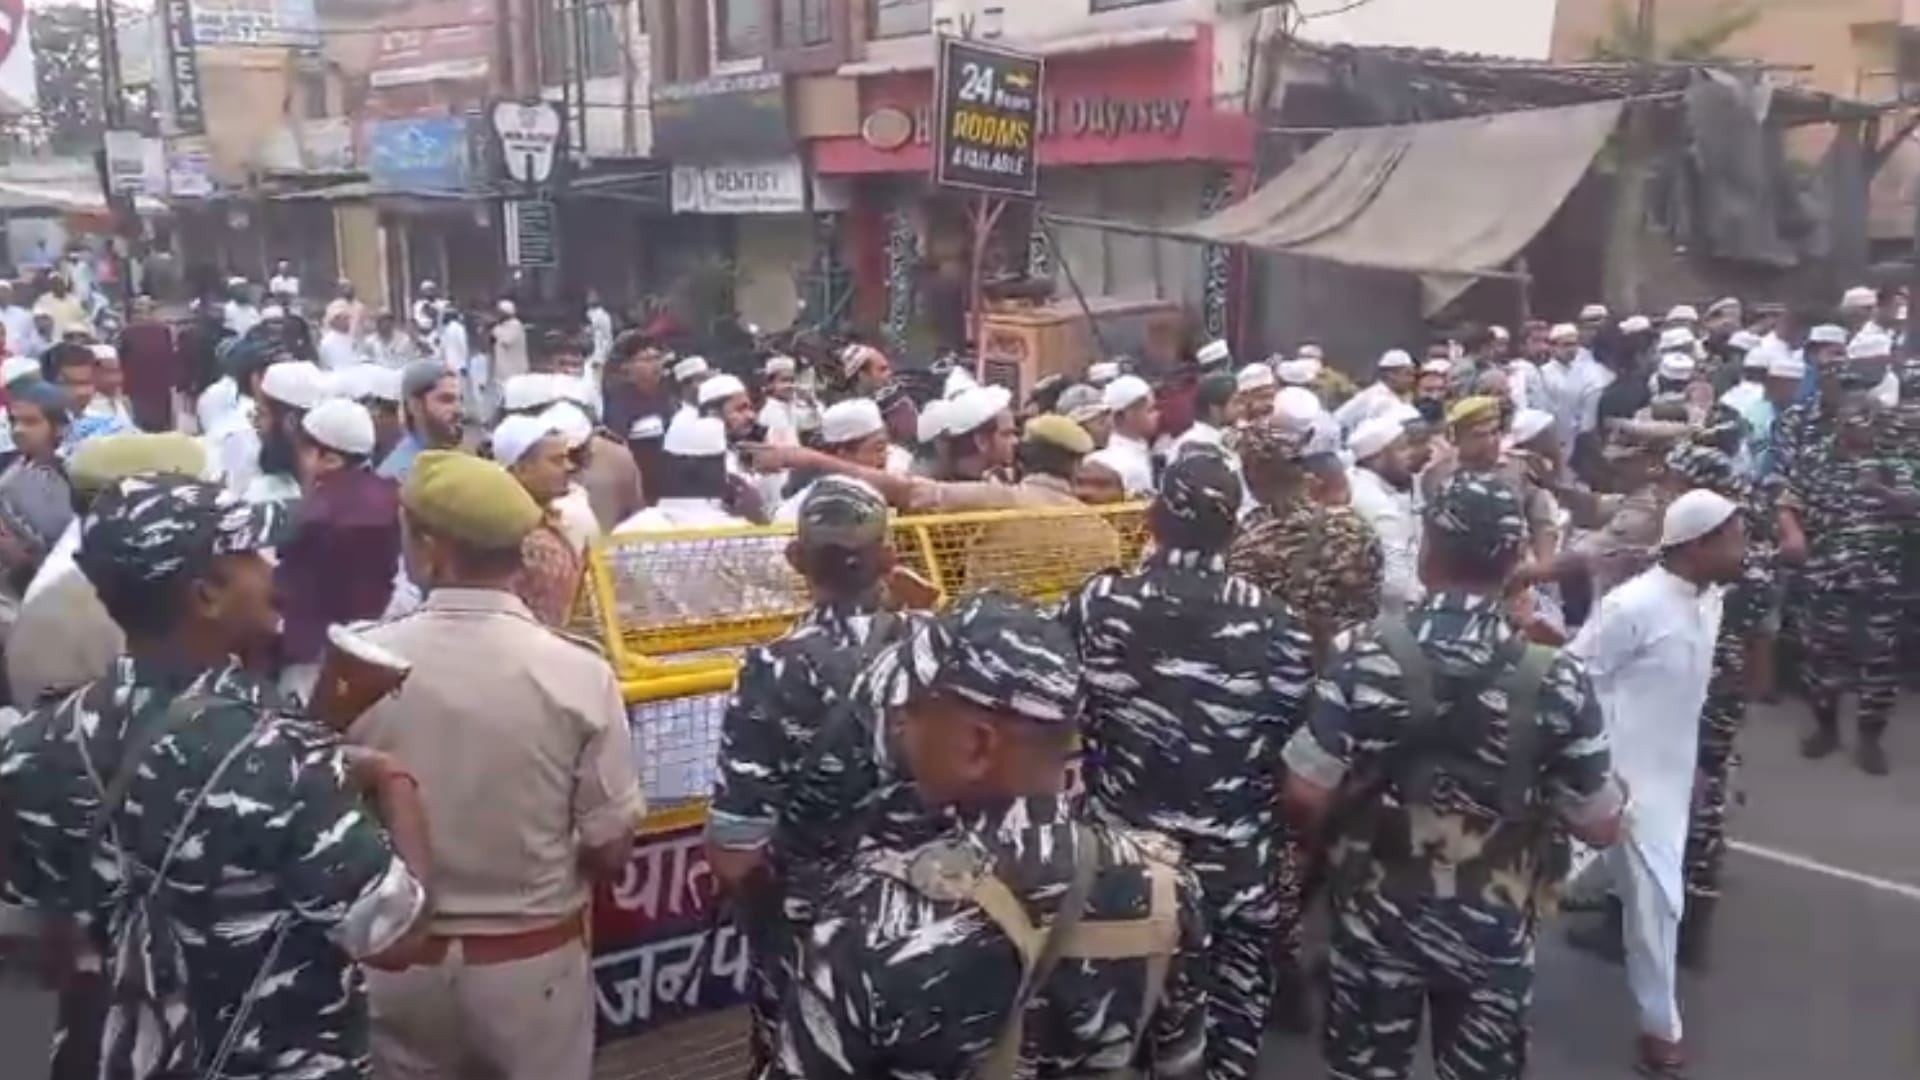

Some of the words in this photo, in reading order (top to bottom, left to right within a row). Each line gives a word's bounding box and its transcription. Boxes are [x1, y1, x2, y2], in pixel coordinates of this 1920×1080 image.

[170, 1, 198, 109] FLEX
[960, 62, 994, 104] 24
[953, 110, 1030, 149] ROOMS
[952, 145, 1026, 175] AVAILABLE
[714, 171, 779, 192] DENTIST
[613, 835, 719, 919] यात
[593, 925, 750, 1025] जनप
